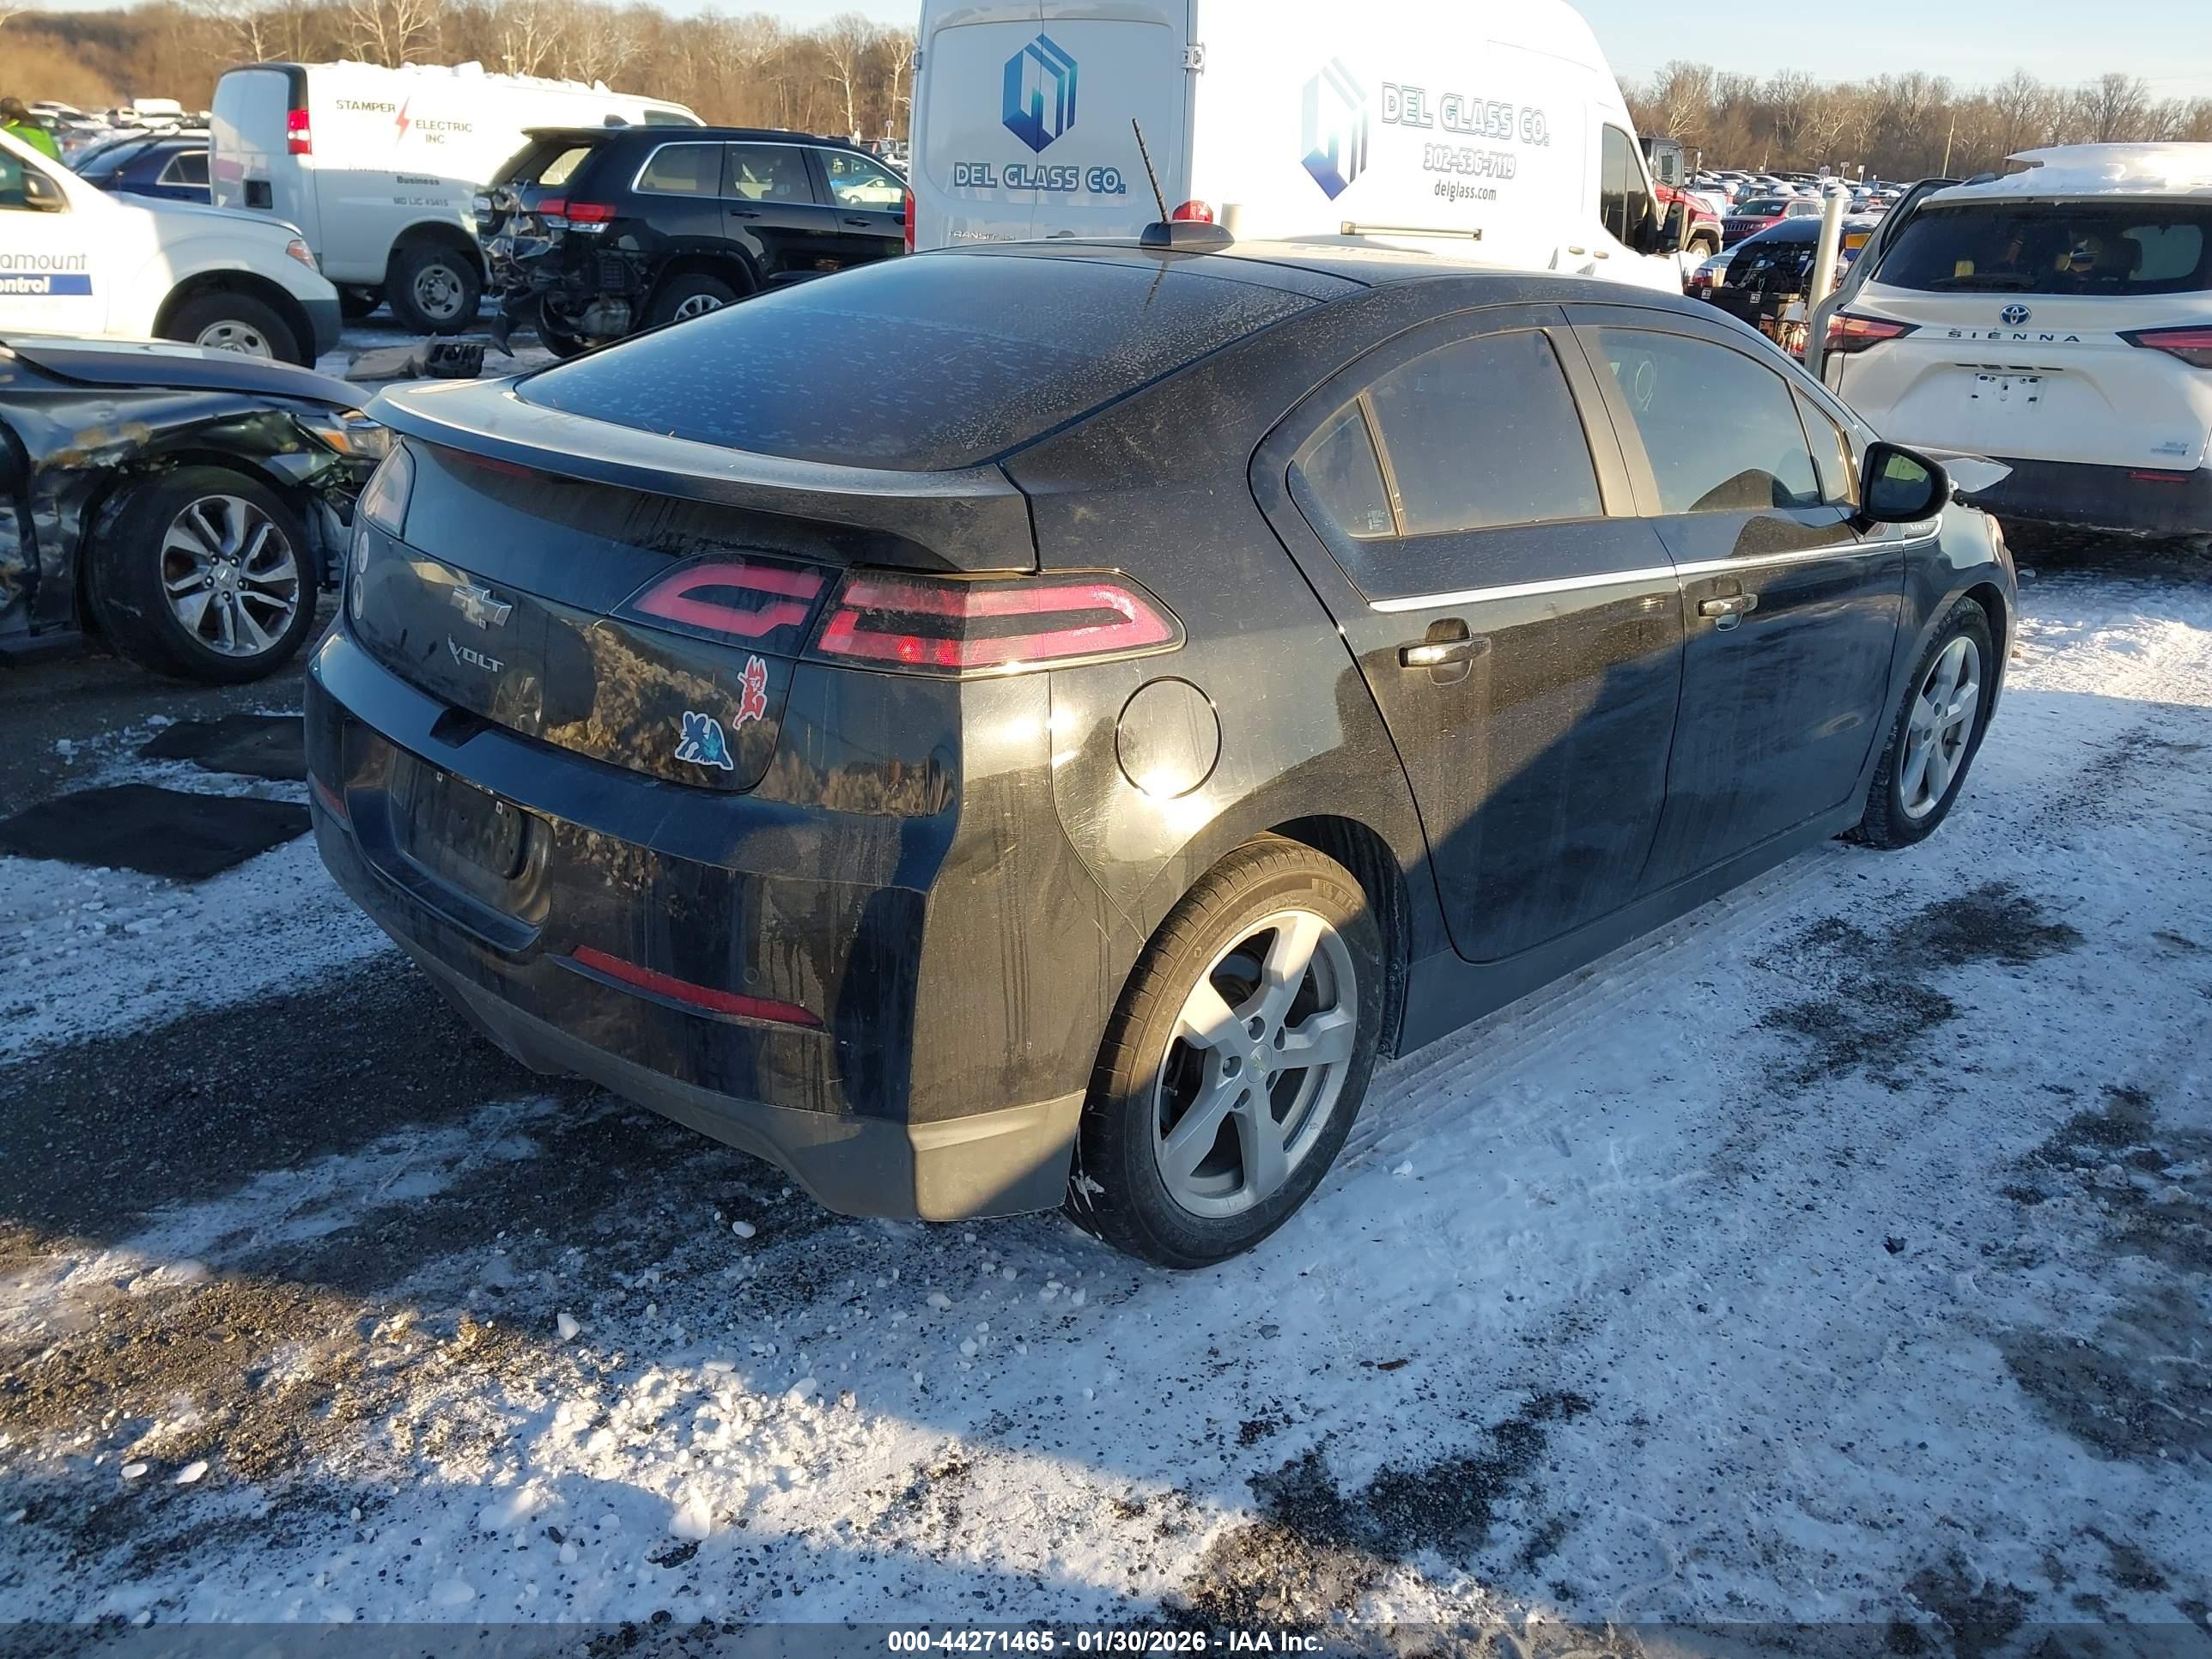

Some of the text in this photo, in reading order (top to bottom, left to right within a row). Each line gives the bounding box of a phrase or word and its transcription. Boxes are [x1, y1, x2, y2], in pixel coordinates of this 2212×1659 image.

[336, 99, 396, 113] STAMPER
[1382, 82, 1552, 146] DEL GLASS CO.
[416, 118, 473, 133] ELECTRIC
[1423, 143, 1516, 179] 302-536-7119
[397, 175, 440, 185] Business
[955, 162, 1126, 194] DEL GLASS CO.
[1434, 179, 1497, 203] delglass.com
[0, 252, 87, 270] amount
[1948, 330, 2081, 343] SIENNA
[447, 633, 504, 672] VOLT
